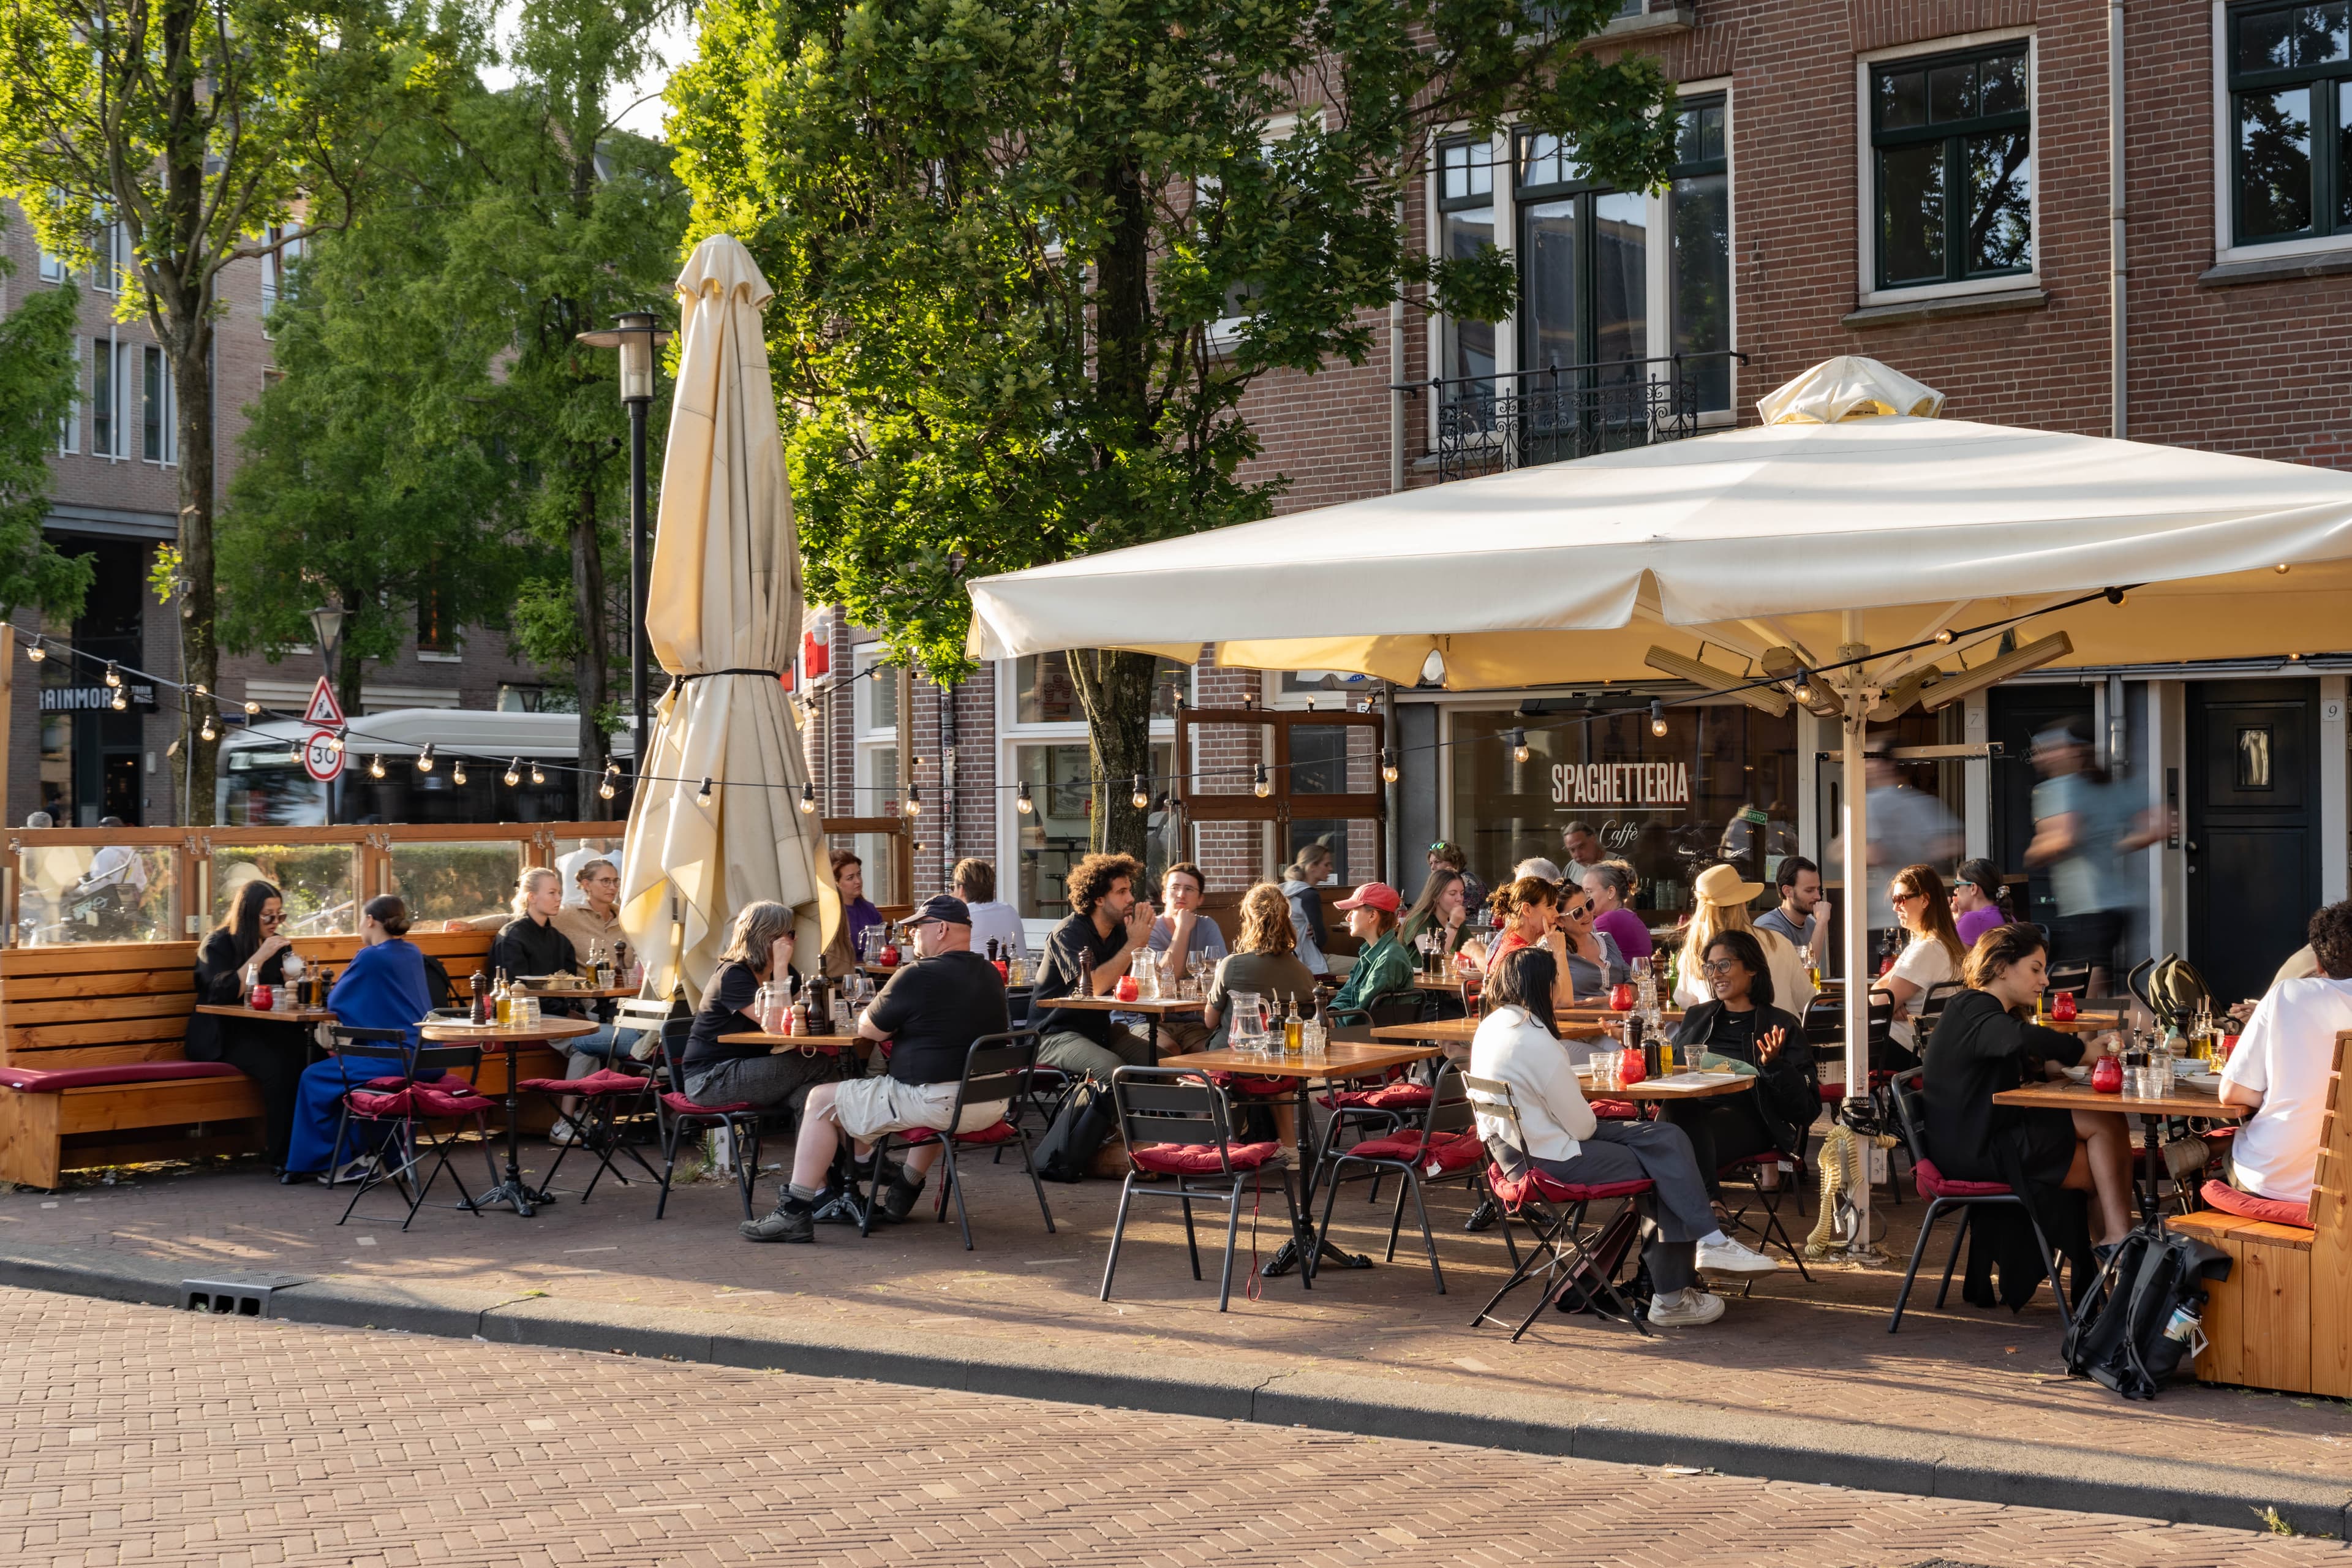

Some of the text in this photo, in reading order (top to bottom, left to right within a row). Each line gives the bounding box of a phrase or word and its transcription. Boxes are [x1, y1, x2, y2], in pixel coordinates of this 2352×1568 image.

[39, 687, 116, 709] RAINMOR
[1971, 714, 1979, 725] 7
[2328, 706, 2337, 717] 9
[312, 748, 336, 764] 30
[1551, 762, 1689, 804] SPAGHETTERIA
[1741, 810, 1765, 821] PERTO
[1599, 820, 1638, 848] Caffè
